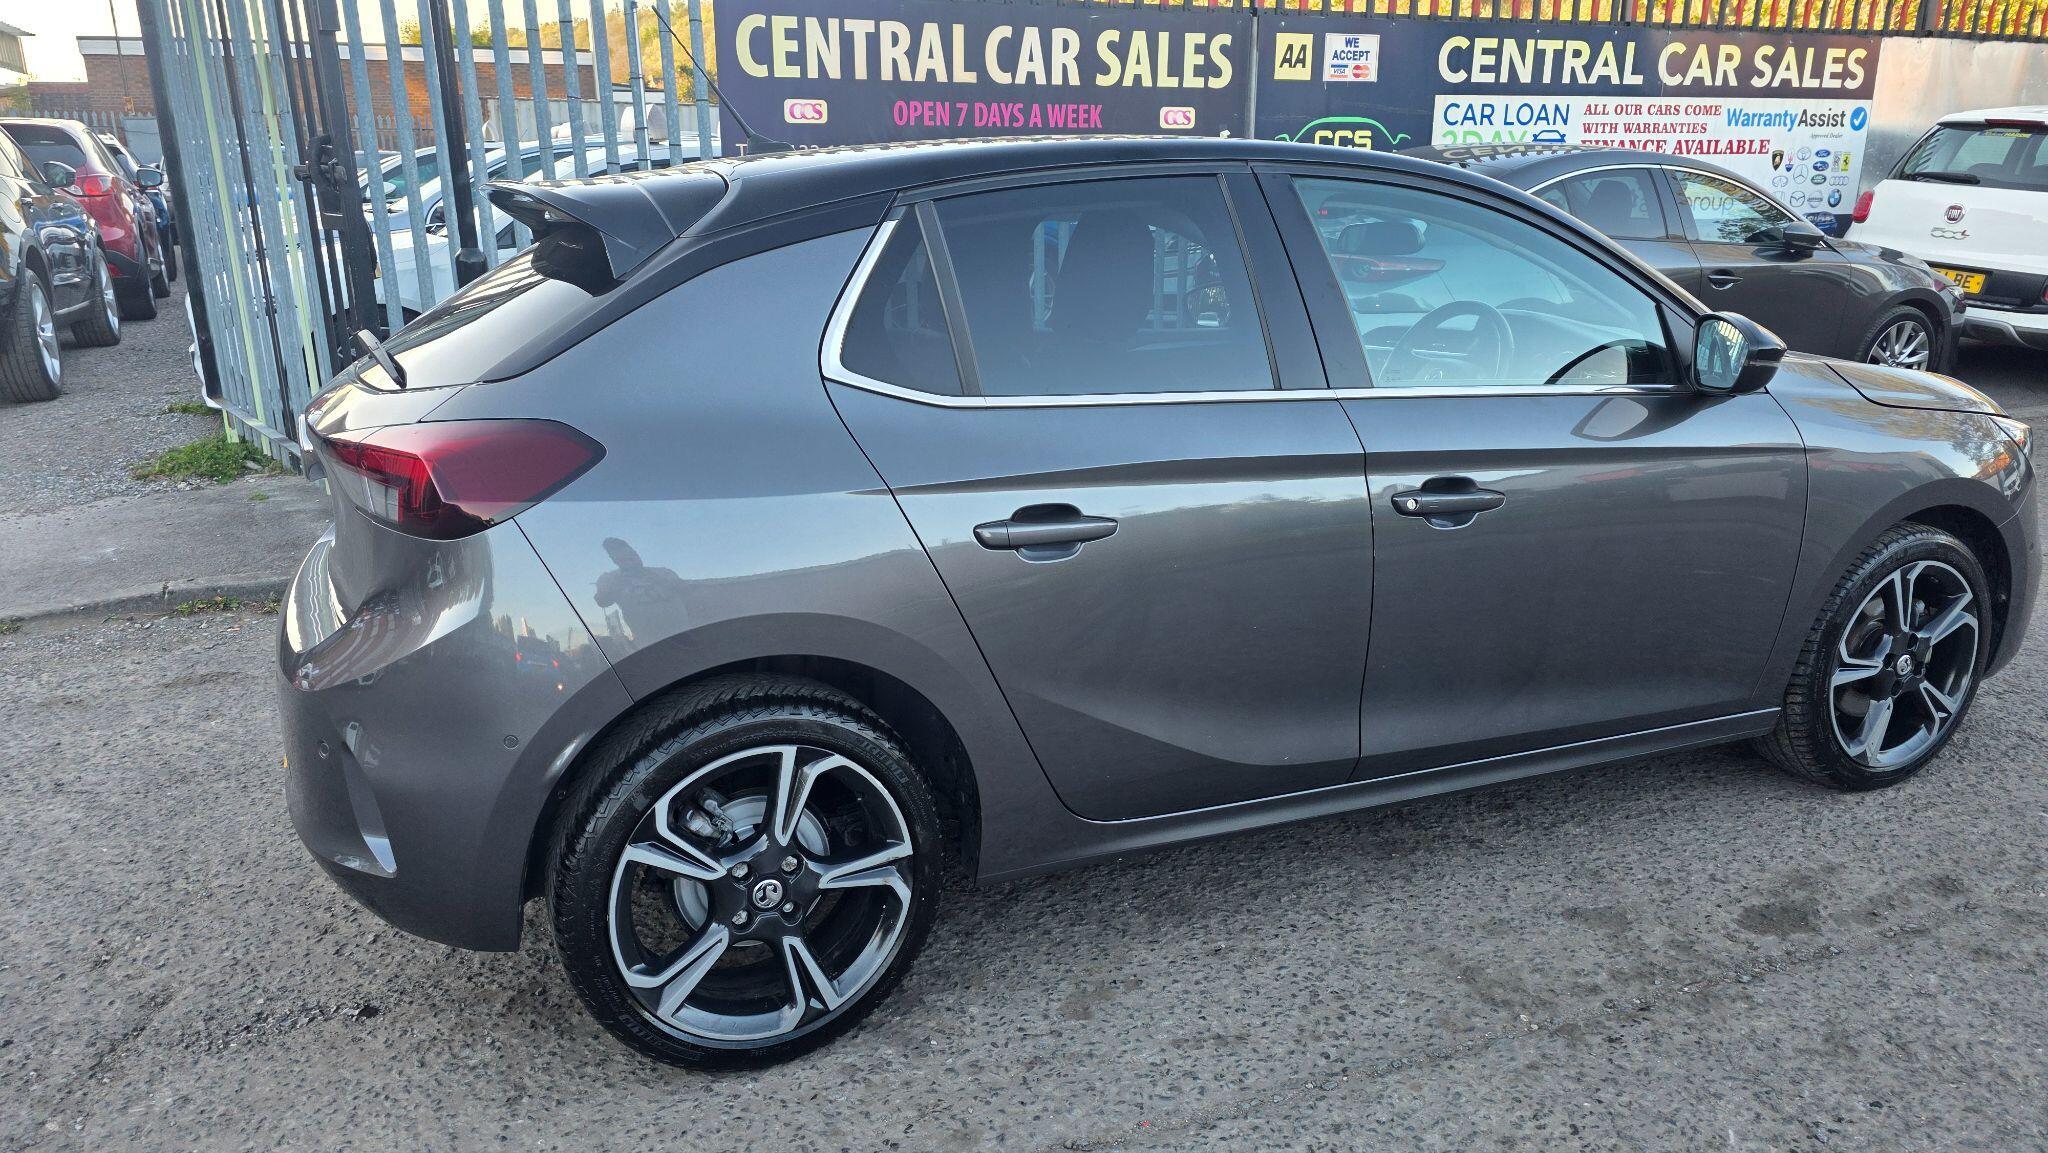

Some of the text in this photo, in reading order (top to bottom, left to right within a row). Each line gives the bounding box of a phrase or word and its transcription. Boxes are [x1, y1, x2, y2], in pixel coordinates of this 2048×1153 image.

[735, 14, 1233, 89] CENTRAL CAR SALES
[1345, 37, 1360, 48] WE
[1279, 43, 1307, 68] AA
[1332, 50, 1370, 61] ACCEPT
[1438, 36, 1868, 90] CENTRAL CAR SALES
[788, 102, 823, 120] CCS
[893, 101, 1103, 129] OPEN 7 DAYS A WEEK
[1164, 110, 1191, 125] CCS
[1443, 102, 1570, 126] CAR LOAN
[1583, 104, 1722, 116] ALL OUR CARS COME
[1582, 122, 1708, 134] WITH WARRANTIES
[1314, 130, 1372, 150] CCS
[1671, 139, 1771, 155] AVAILABLE
